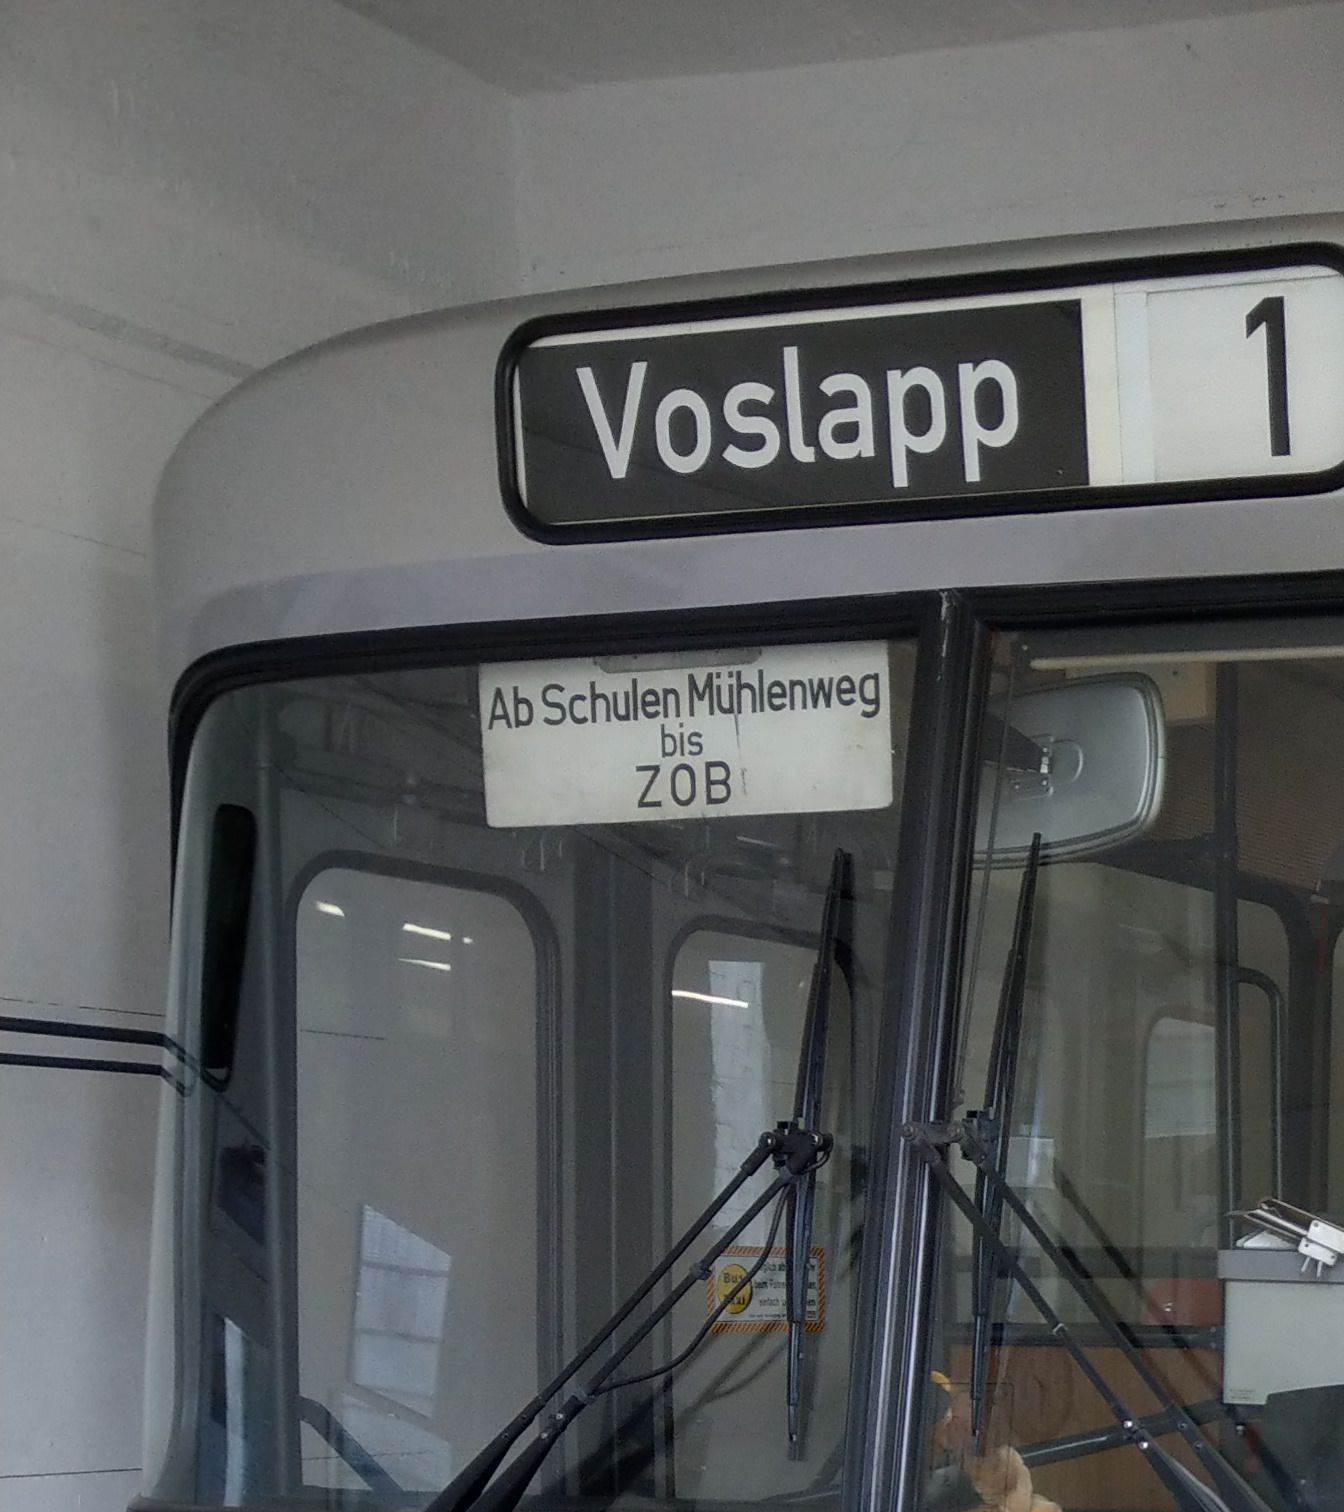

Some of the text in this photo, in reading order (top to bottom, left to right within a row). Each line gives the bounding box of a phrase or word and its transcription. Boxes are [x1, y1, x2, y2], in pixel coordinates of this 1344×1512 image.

[576, 295, 1292, 488] Voslapp 1
[488, 669, 881, 730] Ab Schulen Mühlenweg
[660, 724, 704, 758] bis
[635, 761, 732, 809] ZOB
